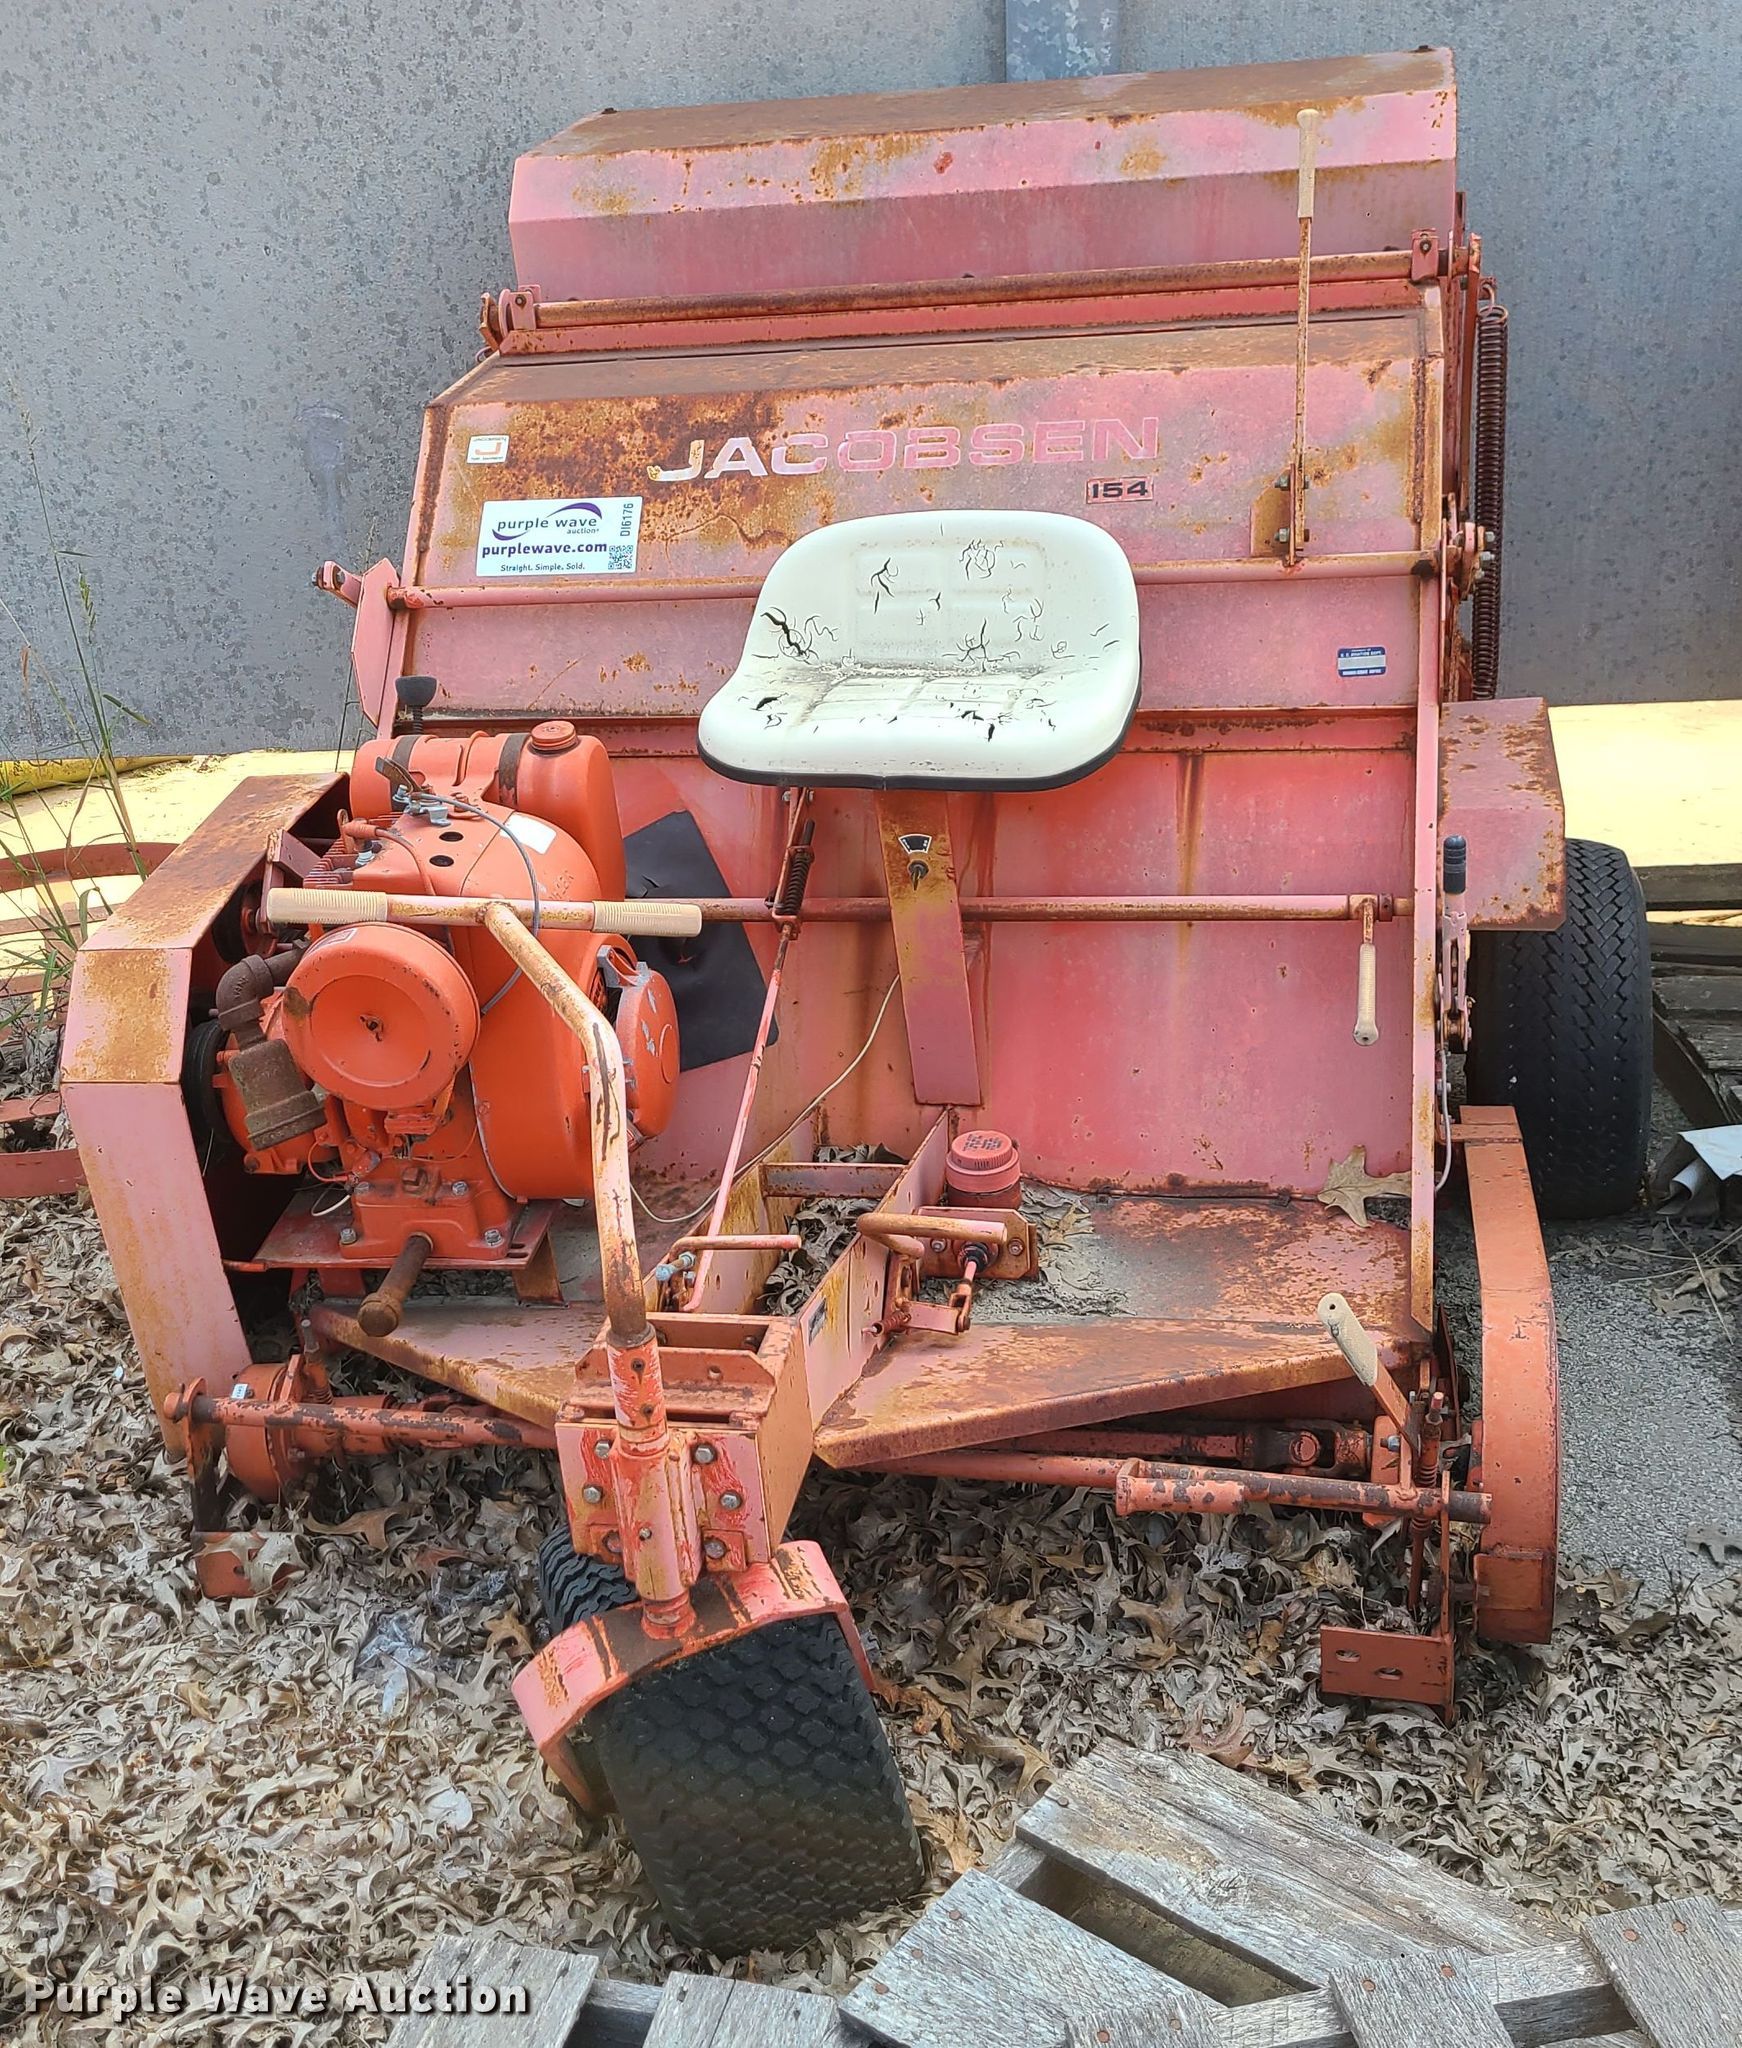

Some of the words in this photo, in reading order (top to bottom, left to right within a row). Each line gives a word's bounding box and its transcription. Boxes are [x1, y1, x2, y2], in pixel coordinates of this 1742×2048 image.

[647, 416, 1158, 482] JACOBSEN
[1091, 480, 1150, 499] 154
[497, 517, 549, 532] purple
[555, 518, 597, 528] wave
[620, 502, 633, 536] DI6176
[481, 542, 608, 558] purplewave.com
[500, 563, 534, 573] Straight.
[535, 563, 565, 573] Simple.
[566, 562, 586, 571] Sold.
